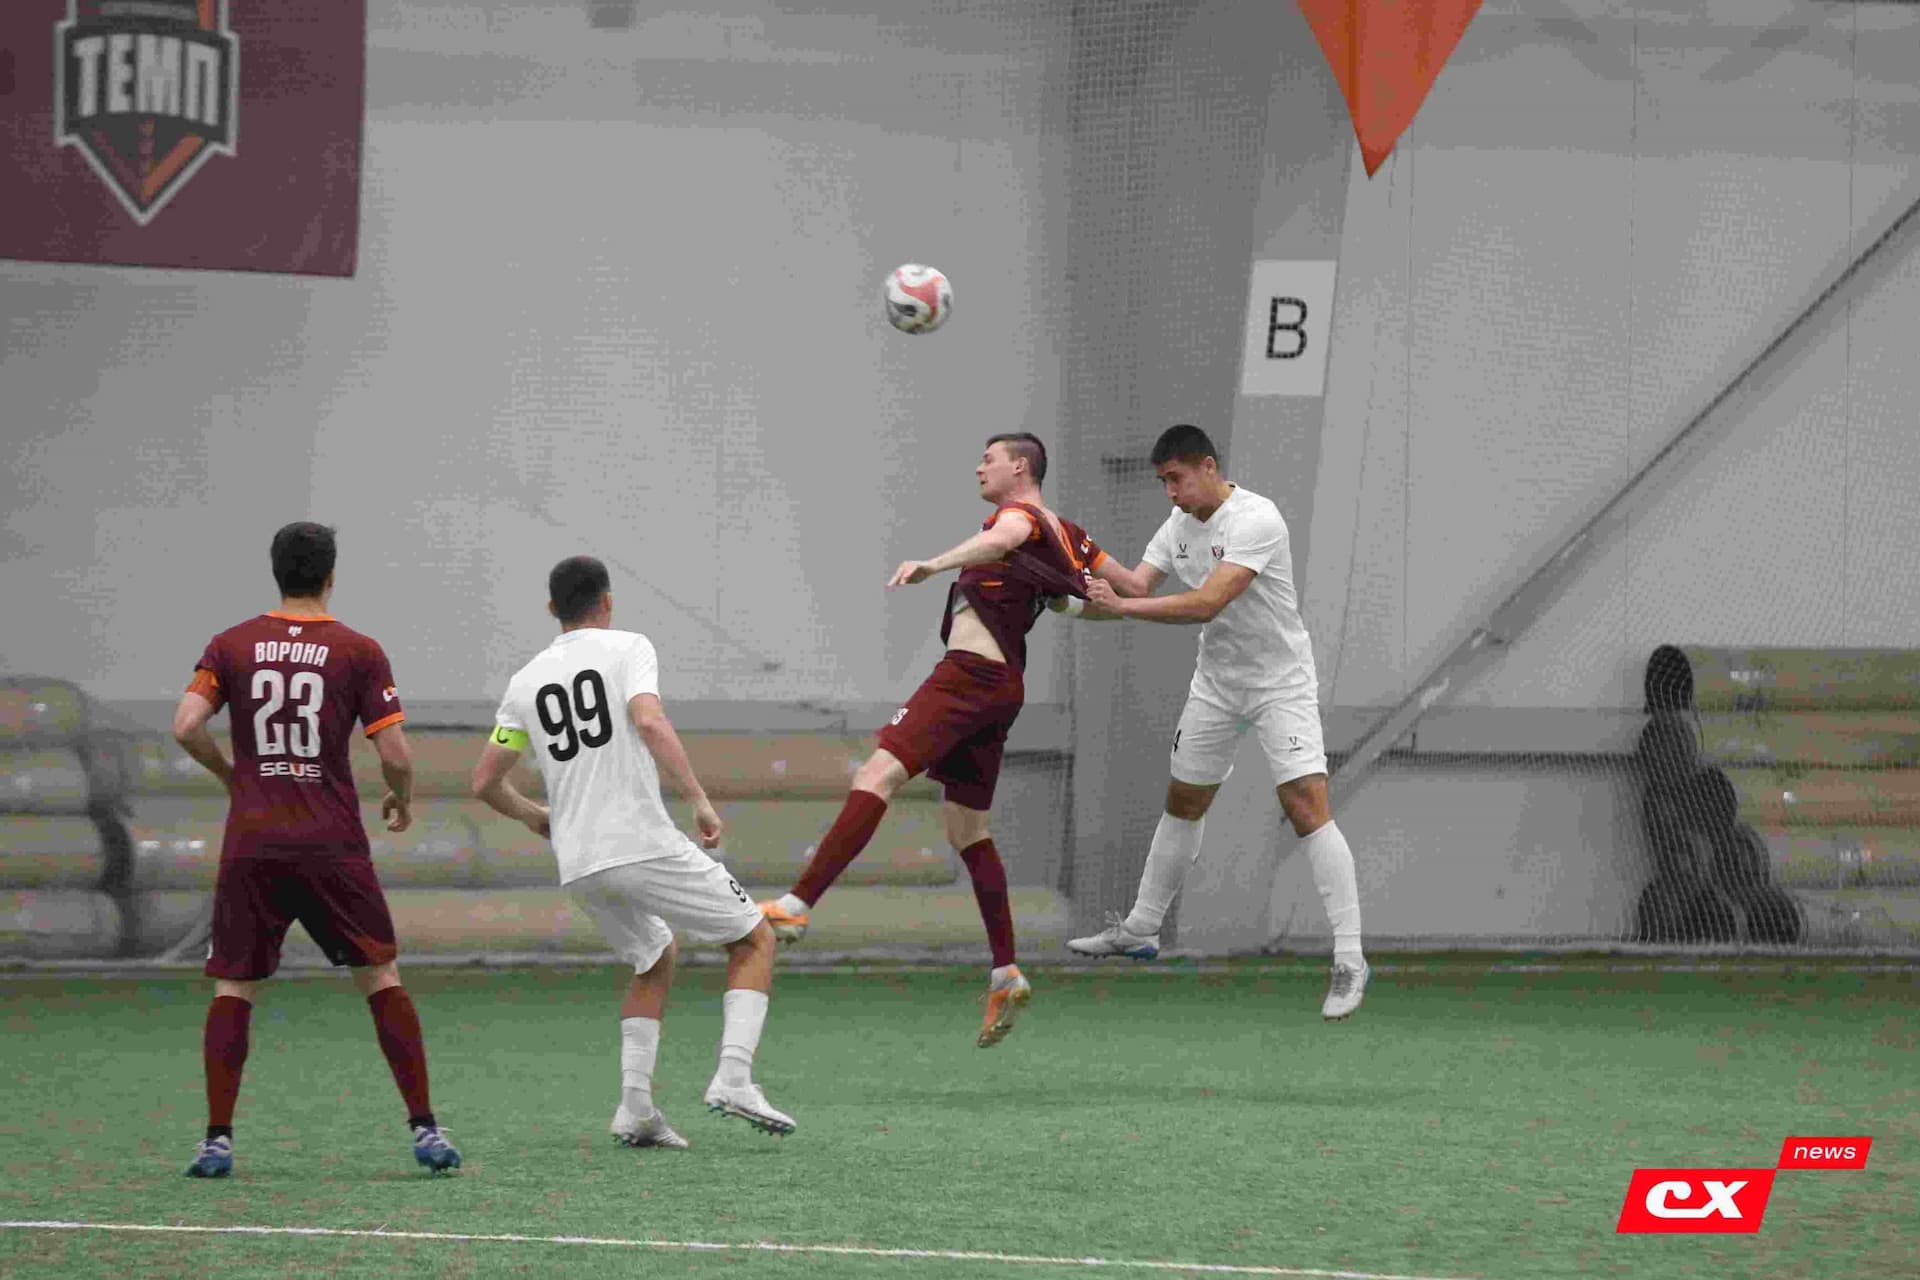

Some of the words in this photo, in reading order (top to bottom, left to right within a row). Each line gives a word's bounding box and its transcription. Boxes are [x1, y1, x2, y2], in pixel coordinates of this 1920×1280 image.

[73, 34, 219, 126] ТЕМП
[1267, 297, 1307, 358] B
[255, 641, 329, 667] ВОРОНА
[251, 669, 324, 758] 23
[535, 669, 613, 761] 99
[260, 761, 322, 778] SEUS
